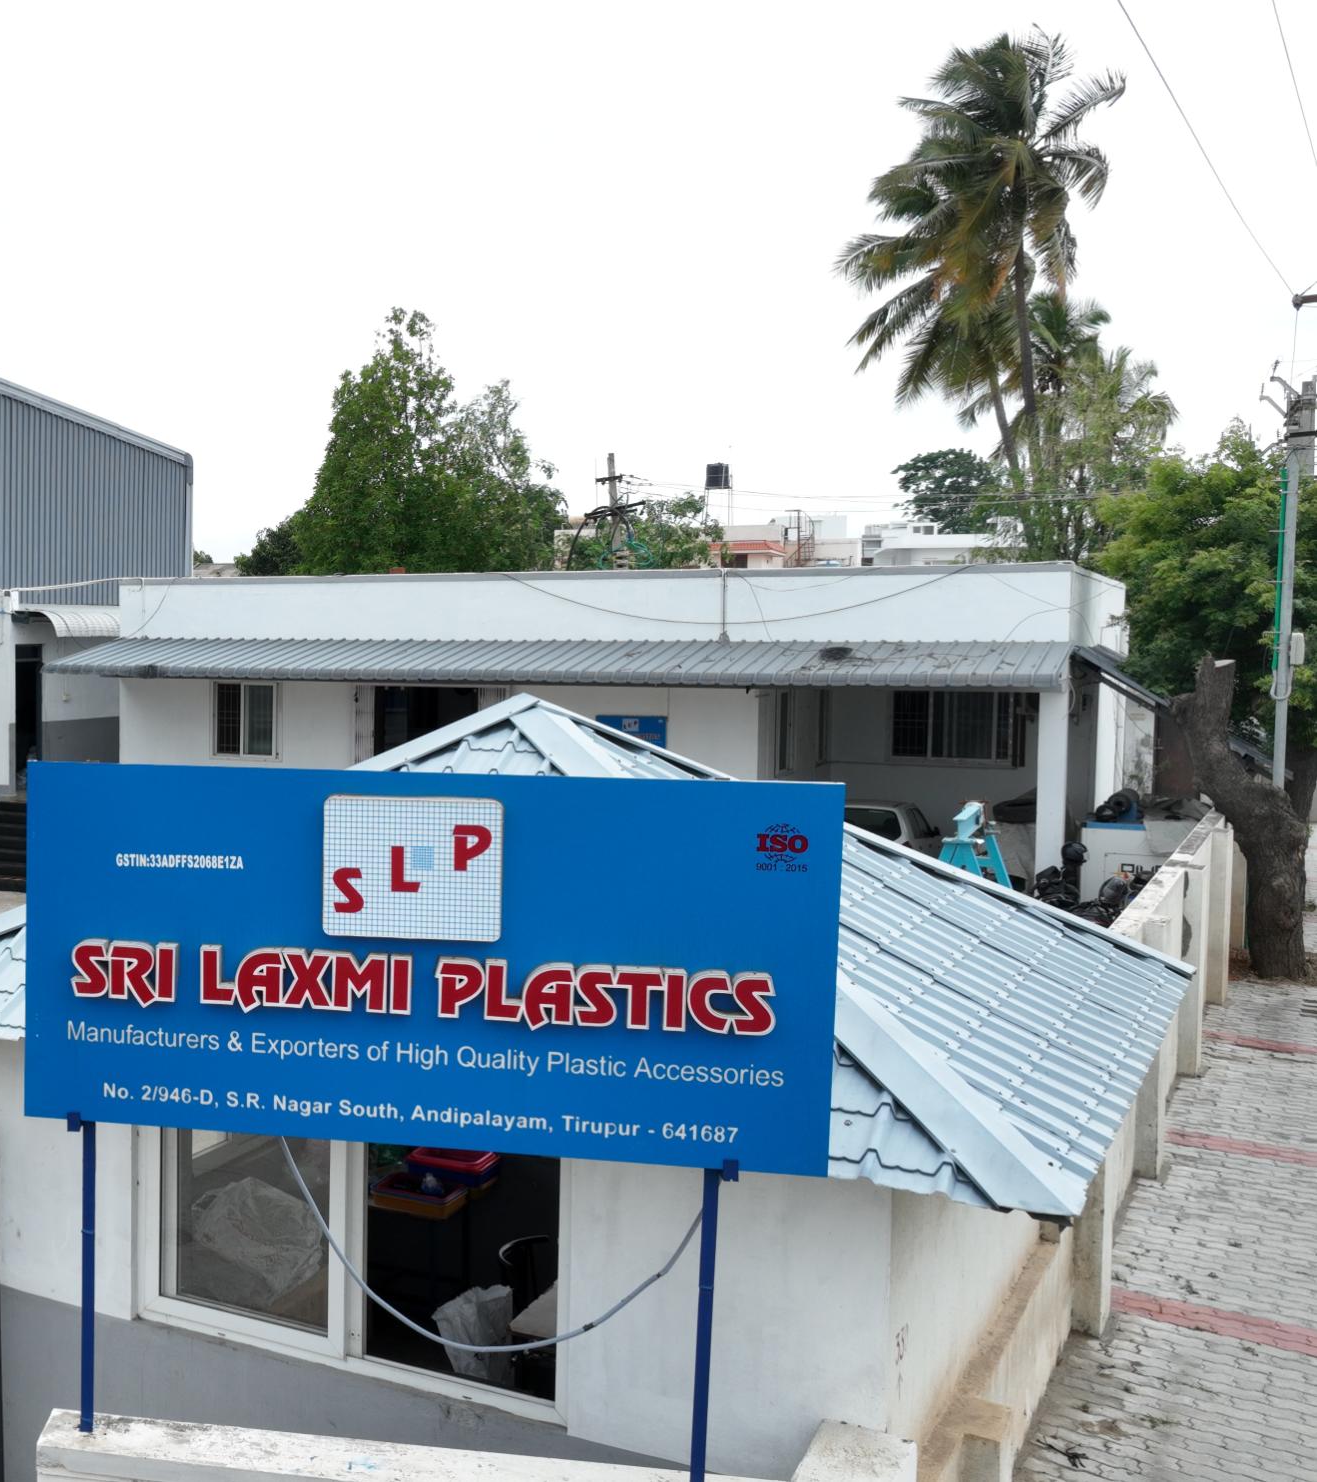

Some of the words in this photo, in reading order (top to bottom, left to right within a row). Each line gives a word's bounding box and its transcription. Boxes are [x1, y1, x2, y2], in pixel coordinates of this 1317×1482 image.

[756, 833, 809, 854] ISO
[71, 938, 179, 1009] SRI
[199, 944, 414, 1014] LAXMI
[435, 955, 777, 1037] PLASTICS
[66, 1020, 220, 1051] Manufacturers
[227, 1030, 244, 1052] &
[251, 1031, 360, 1061] Exporters
[367, 1041, 390, 1061] of
[396, 1043, 449, 1071] High
[456, 1045, 540, 1078] Quality
[547, 1051, 627, 1078] Plastic
[634, 1057, 784, 1088] Accessories
[102, 1082, 134, 1100] No.
[141, 1085, 220, 1109] 2/946-D,
[226, 1092, 266, 1109] S.R.
[273, 1094, 332, 1117] Nagar
[339, 1099, 405, 1122] South,
[411, 1105, 554, 1133] Andipalayam,
[561, 1115, 641, 1138] Tirupur
[662, 1122, 739, 1144] 641687
